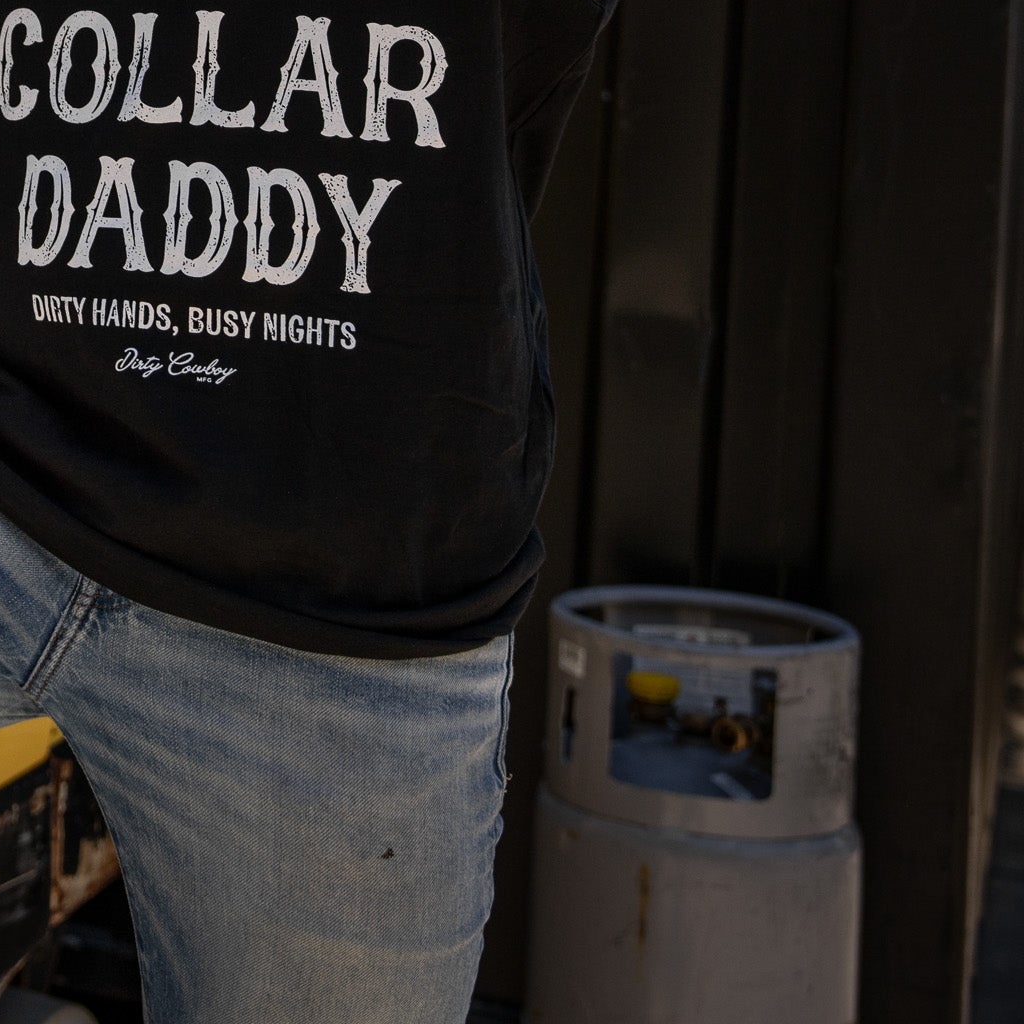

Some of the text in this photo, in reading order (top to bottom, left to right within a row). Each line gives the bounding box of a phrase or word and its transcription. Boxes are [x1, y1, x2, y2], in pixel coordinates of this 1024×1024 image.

[17, 154, 402, 294] DADDY
[32, 294, 357, 350] DIRTY HANDS, BUSY NIGHTS
[115, 347, 237, 385] Dirty Cowboy
